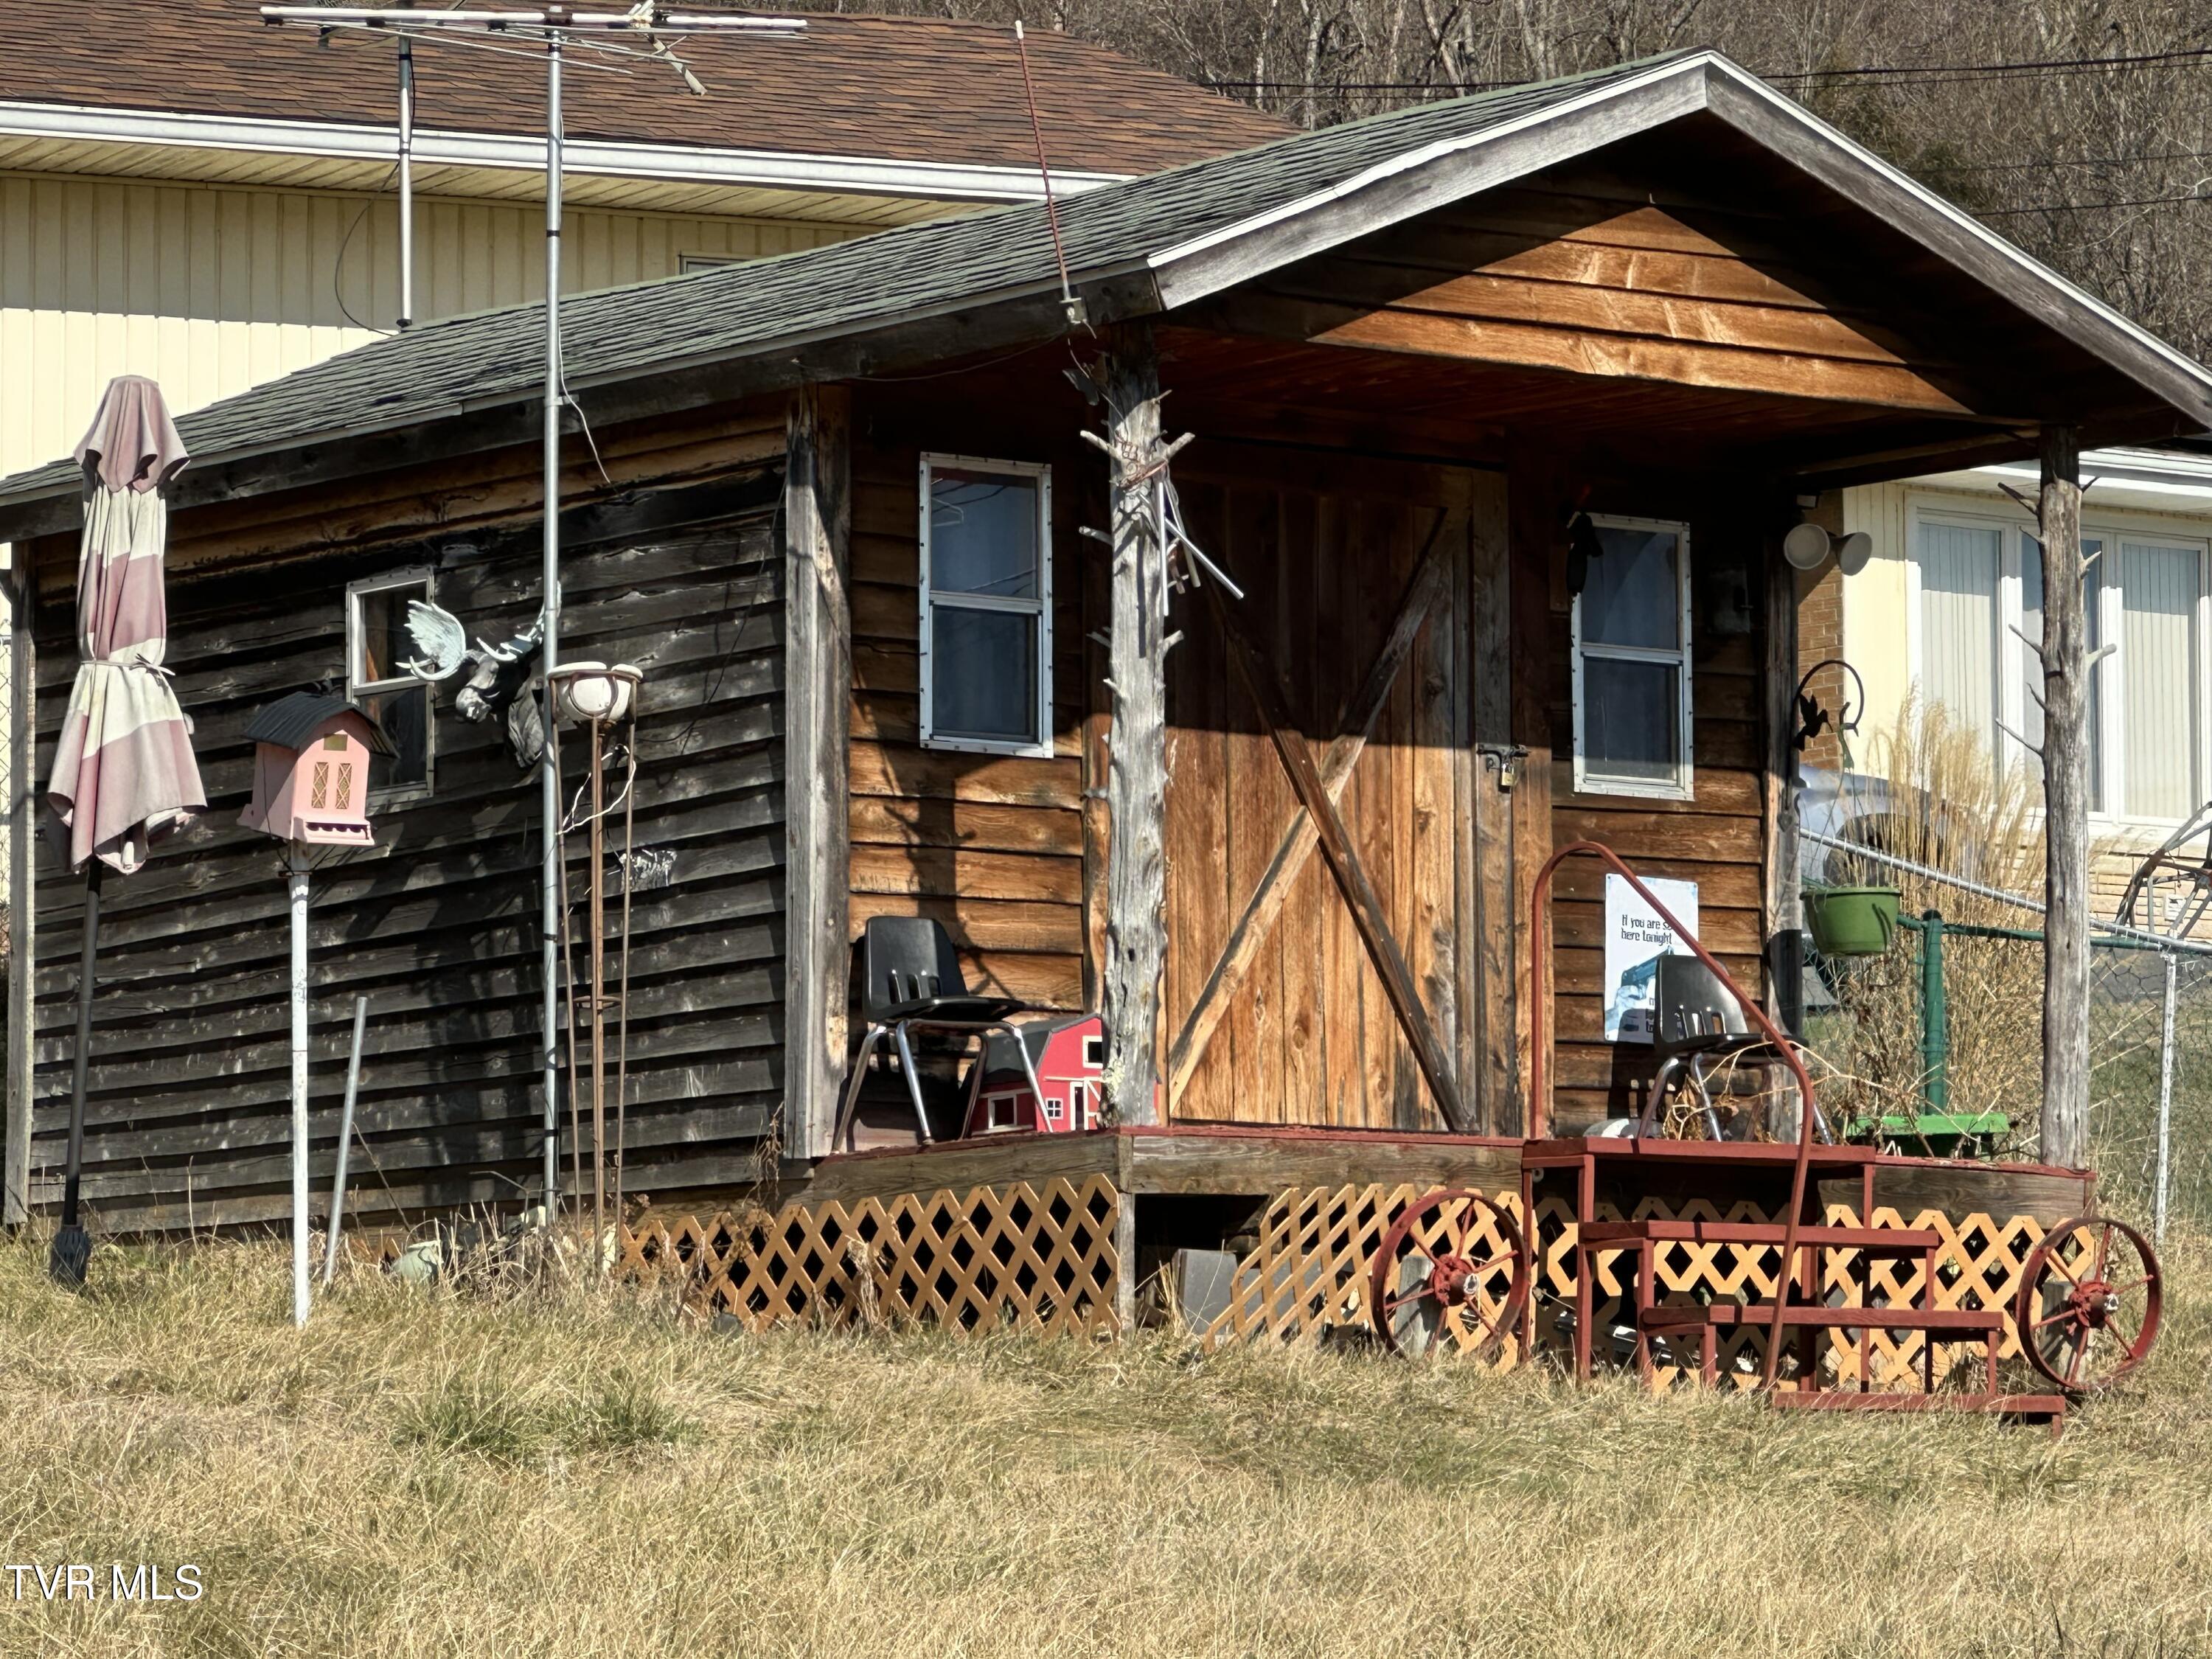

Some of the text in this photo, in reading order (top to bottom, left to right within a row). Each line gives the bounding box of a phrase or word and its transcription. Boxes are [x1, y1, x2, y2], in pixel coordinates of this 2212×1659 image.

[1630, 918, 1645, 928] you
[1646, 920, 1660, 930] are
[1621, 928, 1672, 947] here tonight
